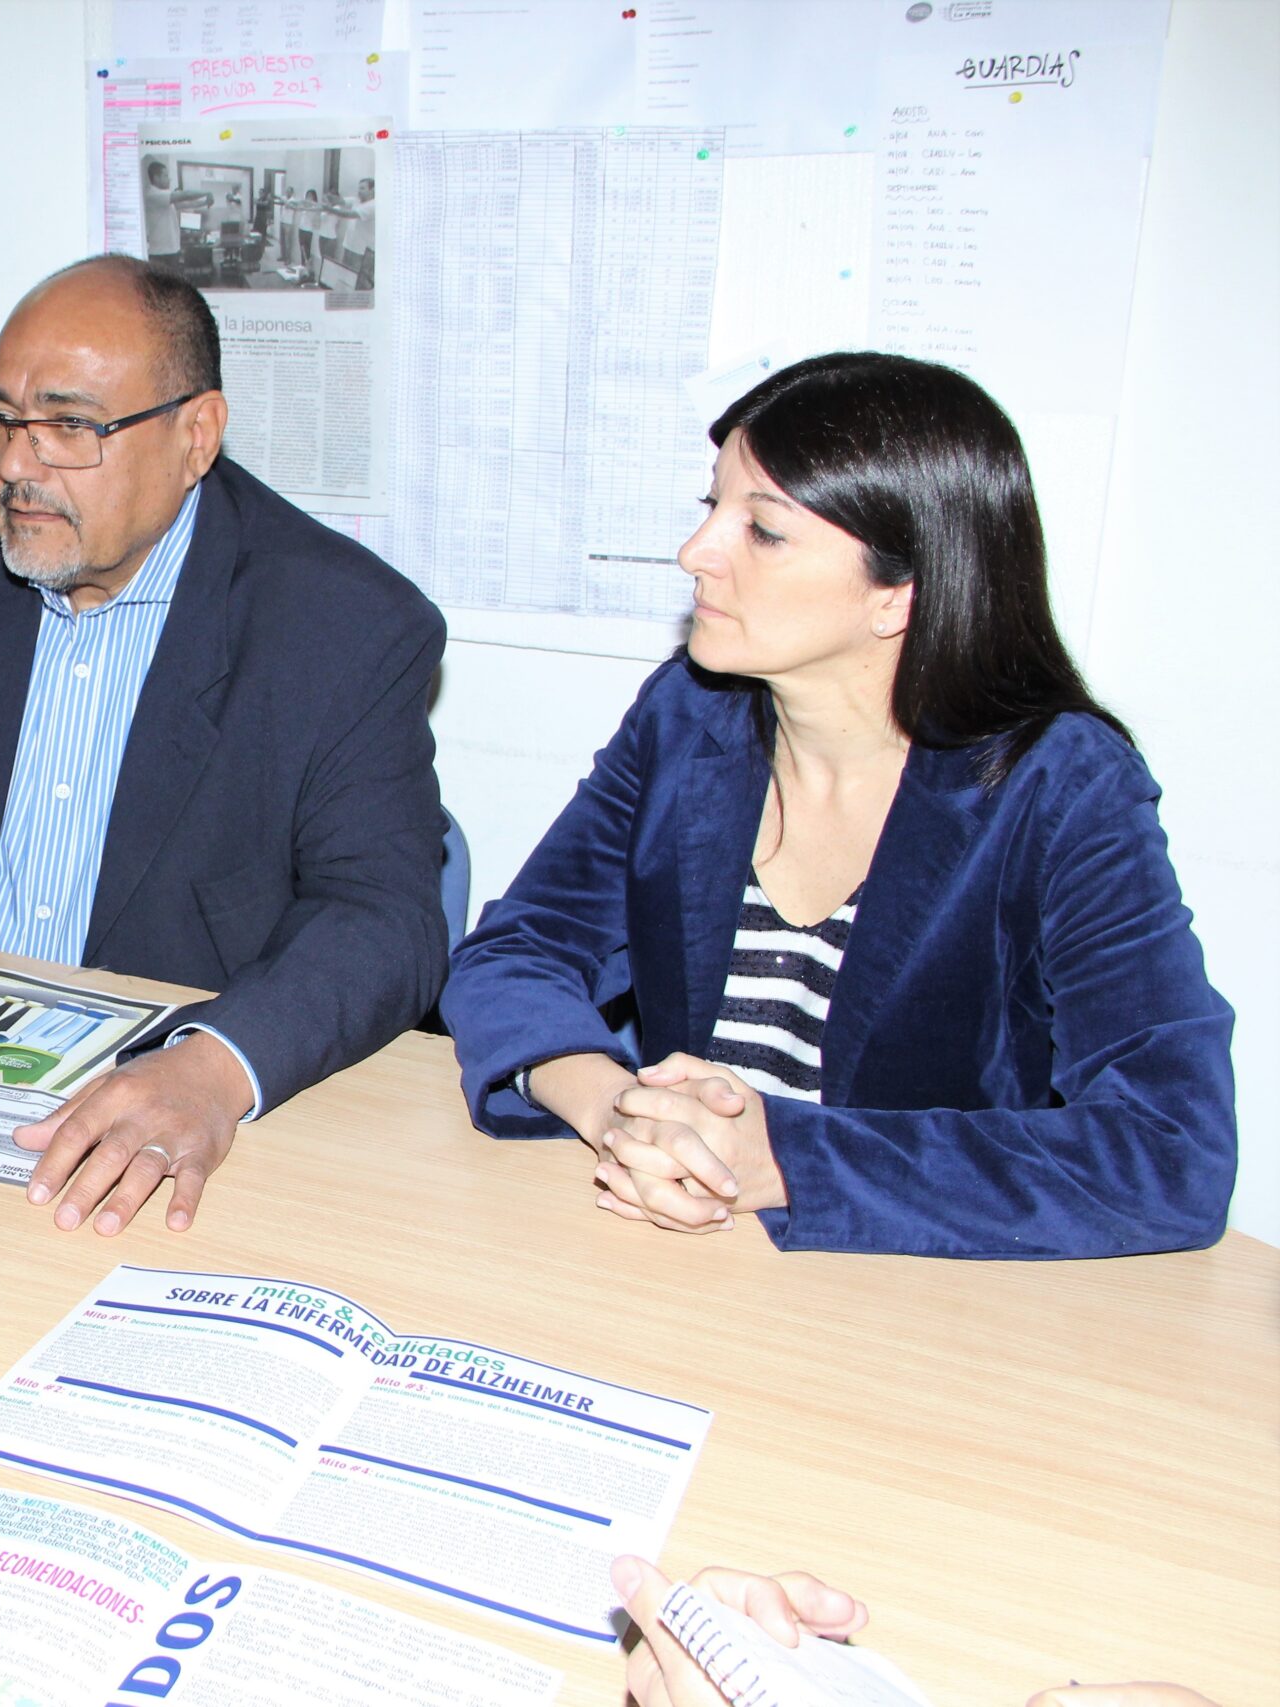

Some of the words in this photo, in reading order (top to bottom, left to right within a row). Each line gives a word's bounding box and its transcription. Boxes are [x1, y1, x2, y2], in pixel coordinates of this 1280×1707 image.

[189, 55, 315, 81] PRESUPUESTO
[271, 77, 322, 97] 2017
[955, 49, 1081, 88] GUARDIAS
[145, 138, 192, 146] PSICOLOGÍA
[224, 315, 237, 330] la
[241, 316, 313, 335] japonesa
[82, 1308, 109, 1322] Mito
[252, 1284, 327, 1310] mitos
[333, 1302, 355, 1324] &
[360, 1321, 506, 1373] realidades
[165, 1287, 240, 1307] SOBRE
[240, 1296, 275, 1313] LA
[275, 1302, 418, 1371] ENFERMEDAD
[421, 1357, 456, 1378] DE
[458, 1366, 595, 1413] ALZHEIMER
[13, 1376, 40, 1390] Mito
[80, 1393, 128, 1408] enfermedad
[131, 1403, 142, 1411] de
[144, 1405, 185, 1420] Alzheimer
[373, 1375, 403, 1389] Mito
[503, 1405, 546, 1422] Alzheimer
[604, 1433, 629, 1446] parte
[631, 1441, 663, 1456] normal
[318, 1456, 348, 1470] Mito
[385, 1474, 439, 1493] enfermedad
[451, 1491, 495, 1508] Alzheimer
[507, 1507, 535, 1521] puede
[1, 1503, 47, 1521] mayores.
[49, 1512, 72, 1525] Uno
[73, 1517, 89, 1529] de
[88, 1523, 118, 1540] estos
[136, 1543, 157, 1561] que
[157, 1554, 173, 1568] en
[173, 1562, 184, 1577] la
[21, 1497, 61, 1513] MITOS
[63, 1507, 98, 1524] acerca
[100, 1516, 117, 1530] de
[119, 1524, 129, 1535] la
[131, 1530, 190, 1570] MEMORIA
[22, 1531, 38, 1542] un
[38, 1533, 88, 1558] deterioro
[87, 1551, 103, 1563] de
[102, 1556, 123, 1573] ese
[48, 1528, 75, 1543] Esta
[75, 1537, 124, 1563] creencia
[124, 1557, 140, 1570] es
[107, 1537, 121, 1551] el
[125, 1546, 179, 1584] deterioro
[104, 1573, 242, 1707] DOS
[340, 1670, 386, 1692] benigno
